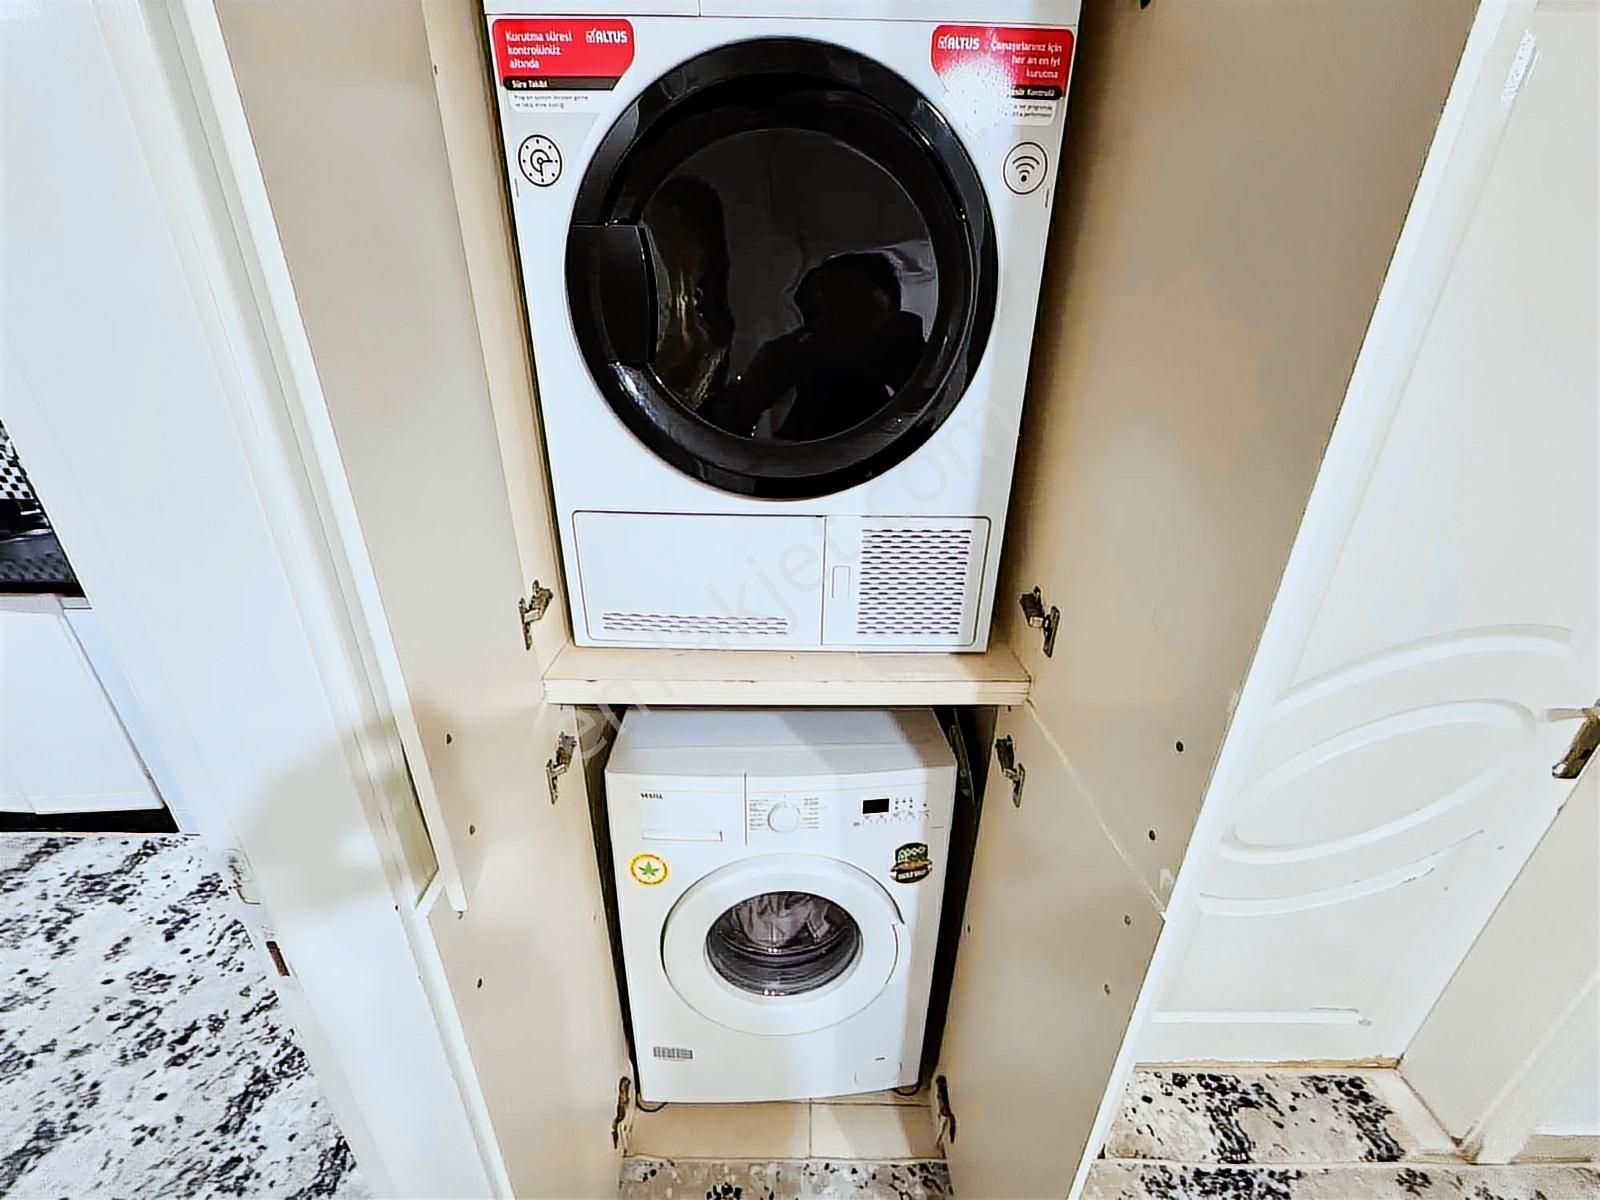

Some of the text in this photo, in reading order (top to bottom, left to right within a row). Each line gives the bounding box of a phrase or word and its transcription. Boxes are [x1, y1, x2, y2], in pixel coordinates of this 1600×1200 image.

[505, 30, 572, 42] Kurutma süresi
[595, 30, 628, 44] ALTUS
[947, 35, 980, 50] ALTUS
